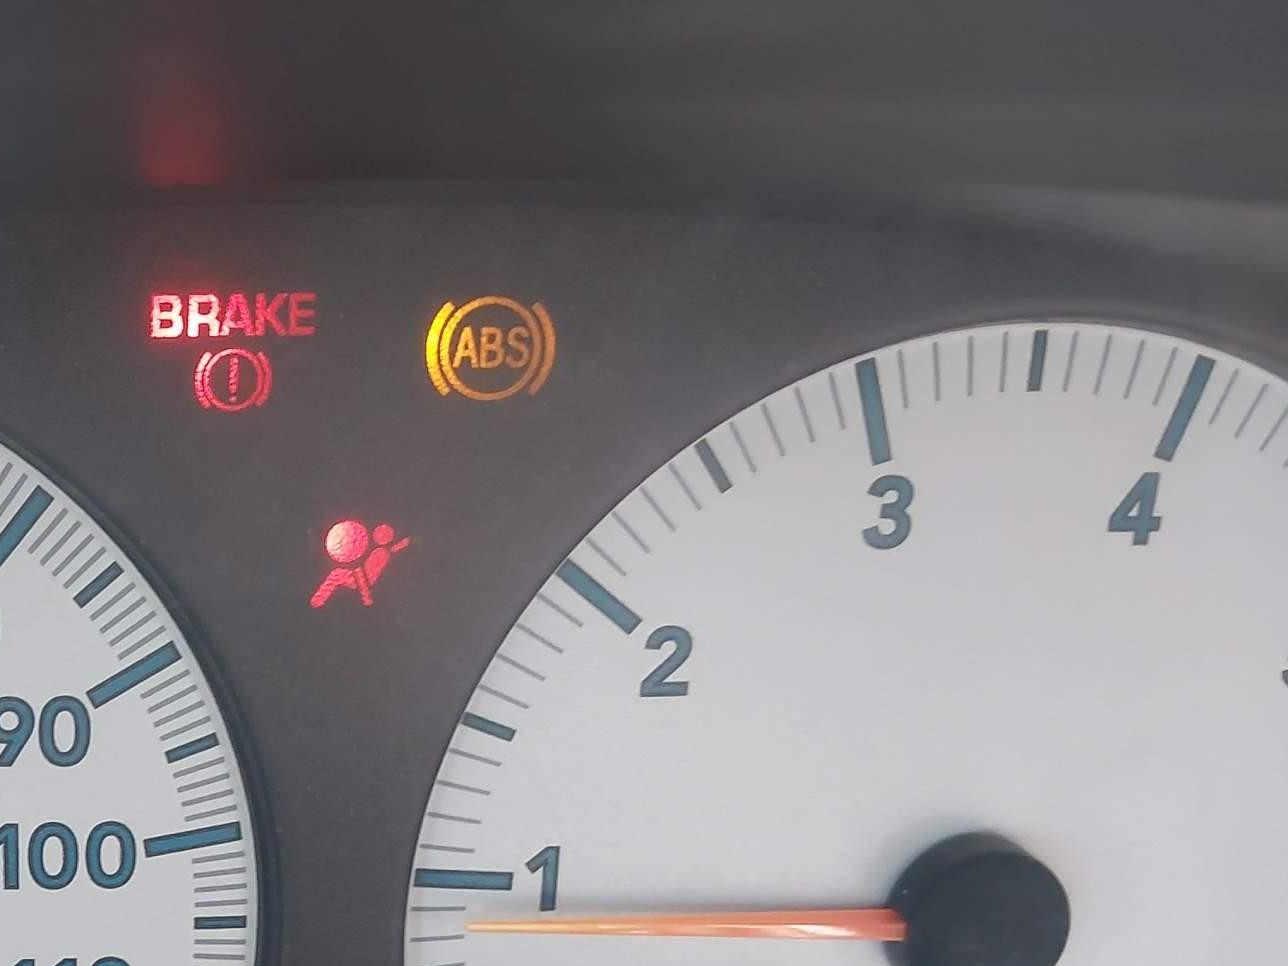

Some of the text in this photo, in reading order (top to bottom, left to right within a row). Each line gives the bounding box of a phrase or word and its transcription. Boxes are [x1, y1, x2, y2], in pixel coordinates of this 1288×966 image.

[150, 293, 317, 337] BRAKE
[453, 326, 530, 368] ABS
[862, 475, 914, 550] 3
[1108, 472, 1162, 545] 4
[640, 625, 692, 697] 2
[525, 846, 560, 912] 1
